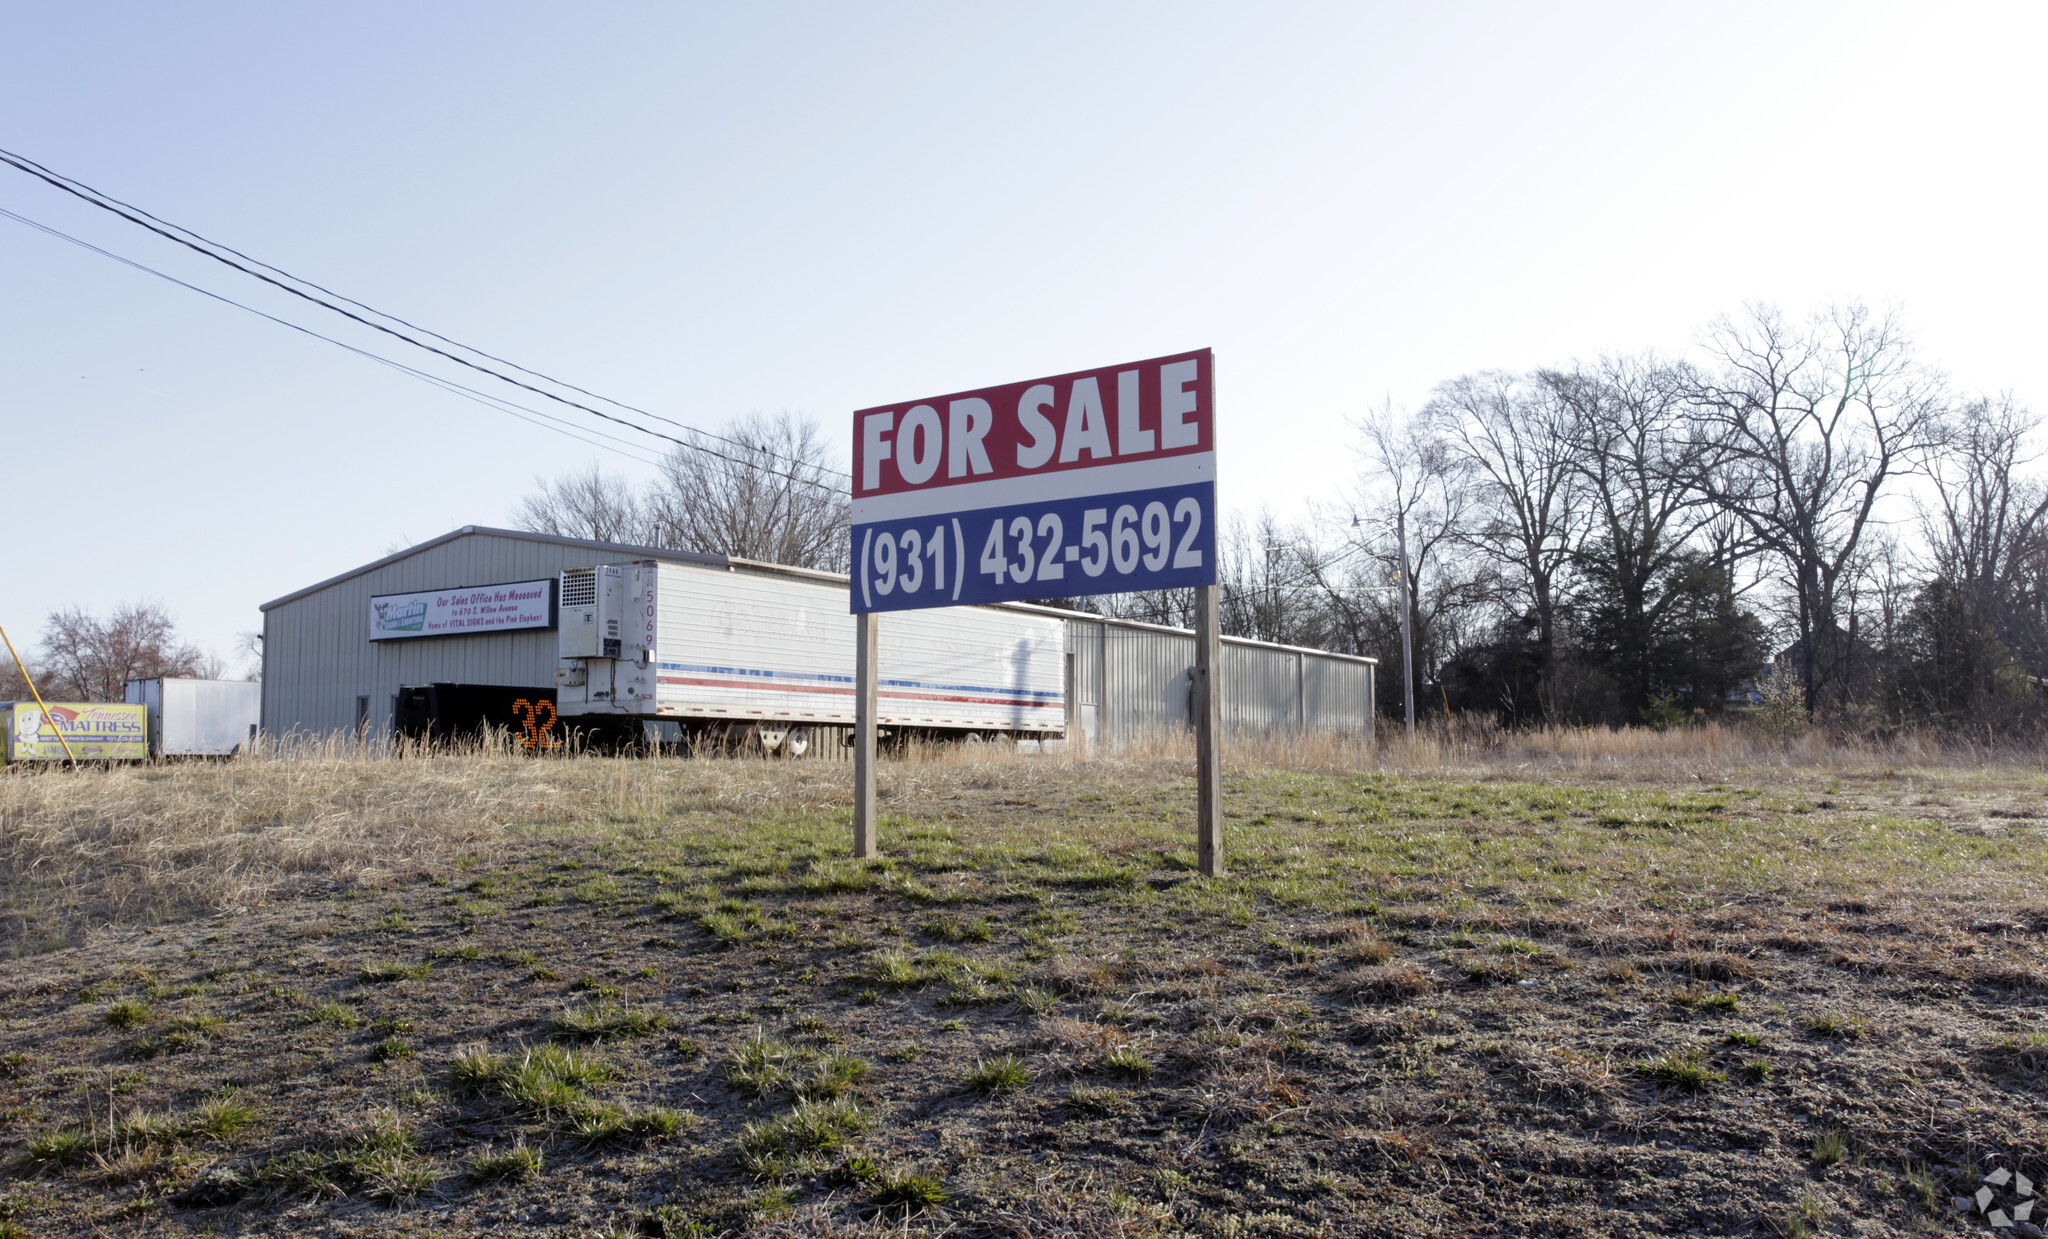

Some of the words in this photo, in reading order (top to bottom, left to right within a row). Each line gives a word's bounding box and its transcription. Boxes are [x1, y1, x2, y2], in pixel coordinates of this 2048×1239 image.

[863, 397, 993, 491] FOR
[1017, 359, 1198, 469] SALE
[861, 518, 964, 608] (931)
[980, 497, 1202, 585] 432-5692
[437, 596, 448, 607] Our
[450, 595, 468, 606] Sales
[470, 593, 492, 604] Office
[494, 590, 506, 602] Has
[384, 599, 424, 621] Martin
[459, 608, 472, 616] 670
[480, 605, 496, 614] Willow
[498, 604, 518, 612] Avenue
[428, 622, 440, 630] Home
[442, 620, 448, 628] of
[450, 618, 465, 628] VITAL
[467, 618, 484, 627] SIGNS
[496, 616, 504, 624] the
[506, 615, 517, 624] Pink
[520, 614, 542, 624] Elephant
[82, 707, 138, 721] Tennessee
[60, 720, 141, 733] MATTRESS
[512, 698, 562, 748] 32
